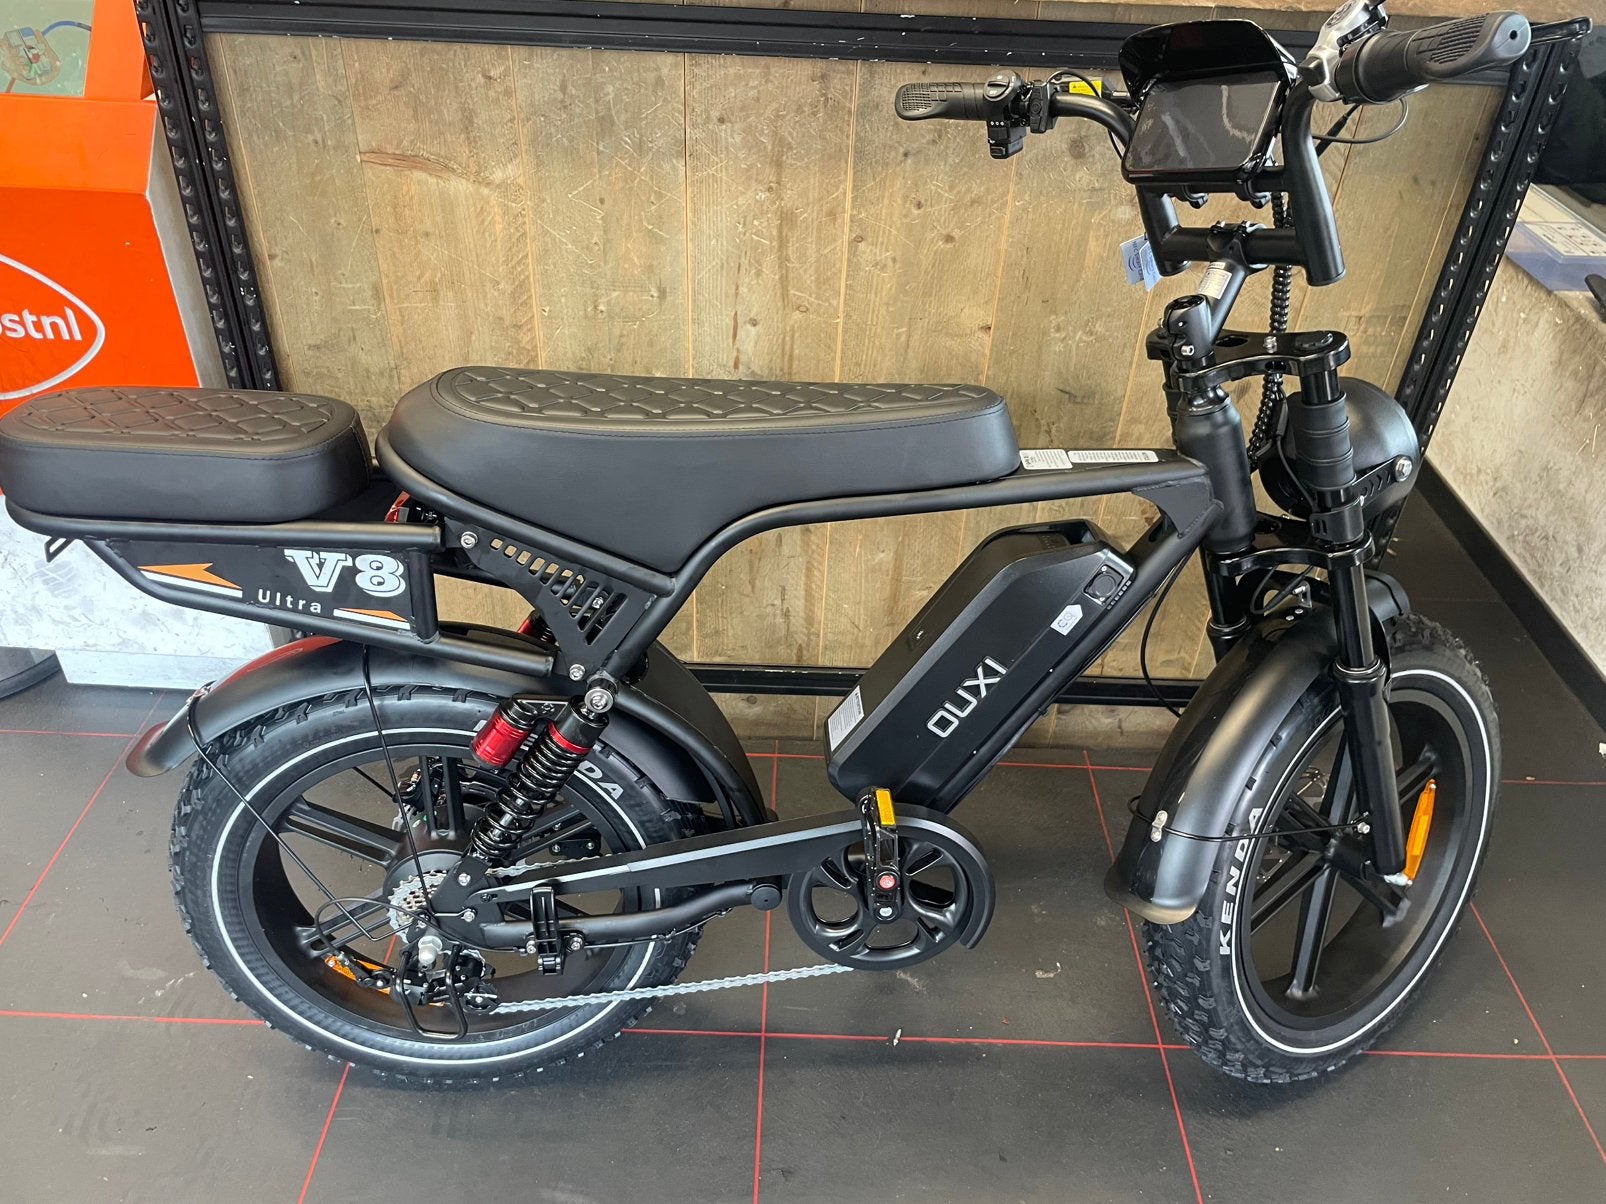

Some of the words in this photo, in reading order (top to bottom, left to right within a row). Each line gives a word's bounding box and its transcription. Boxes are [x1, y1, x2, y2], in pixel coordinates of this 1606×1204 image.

[0, 305, 83, 341] stnl
[283, 548, 406, 598] V8
[258, 588, 322, 614] Ultra
[926, 656, 1008, 738] OUXI
[1219, 807, 1264, 955] KENDA
